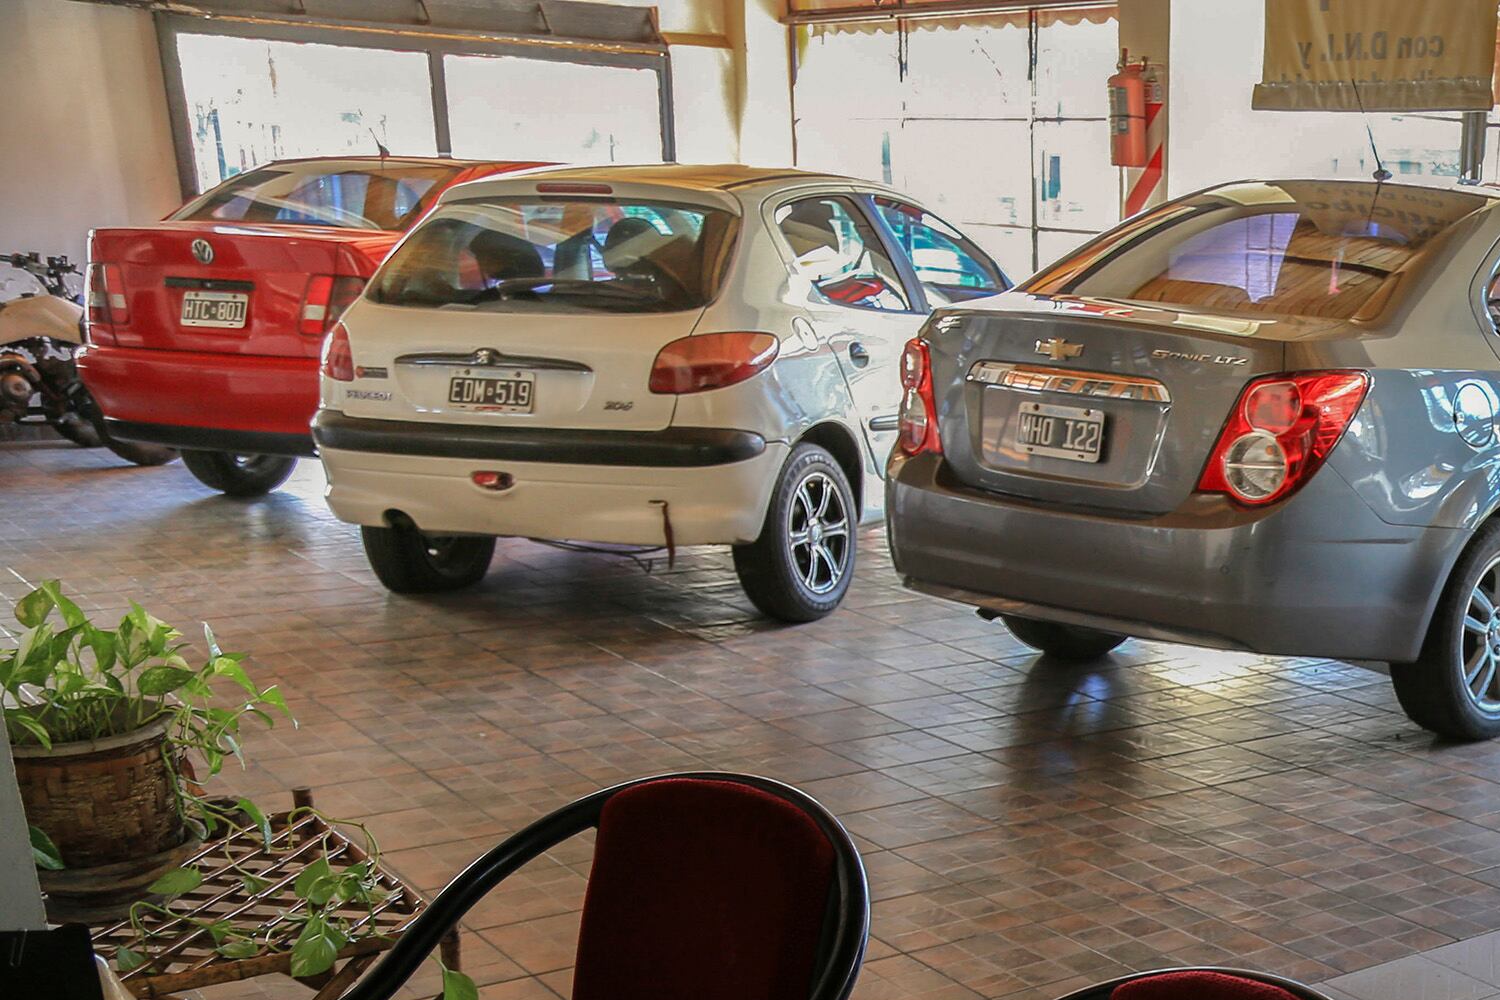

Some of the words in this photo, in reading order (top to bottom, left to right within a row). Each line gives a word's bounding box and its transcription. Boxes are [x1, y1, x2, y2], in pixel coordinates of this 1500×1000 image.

[183, 300, 211, 320] HTC
[217, 302, 243, 321] 801
[1214, 355, 1249, 366] LTZ
[450, 378, 487, 403] EDM
[495, 380, 531, 405] 519
[1061, 420, 1100, 452] 122
